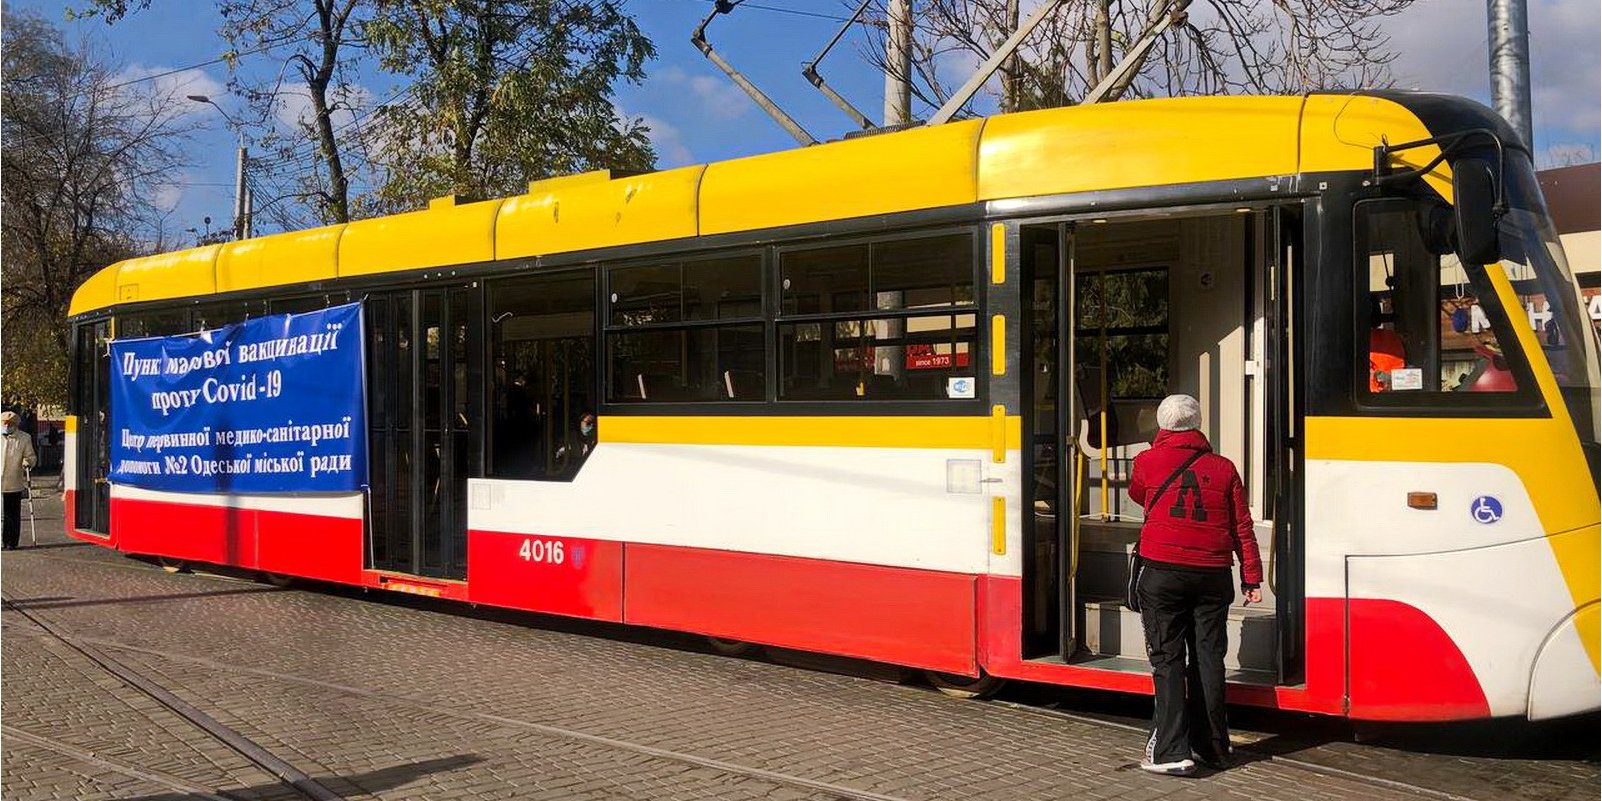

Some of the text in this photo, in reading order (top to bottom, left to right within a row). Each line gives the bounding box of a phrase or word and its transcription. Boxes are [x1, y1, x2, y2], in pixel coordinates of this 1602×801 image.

[123, 352, 161, 381] Пунк
[238, 322, 342, 364] вакцинації
[932, 356, 950, 365] 1973
[121, 429, 144, 453] Цтр
[215, 416, 352, 447] медико-санітарної
[164, 455, 188, 475] №2
[190, 453, 252, 477] Одеської
[254, 451, 304, 475] міської
[310, 454, 352, 478] ради
[519, 538, 565, 565] 4016
